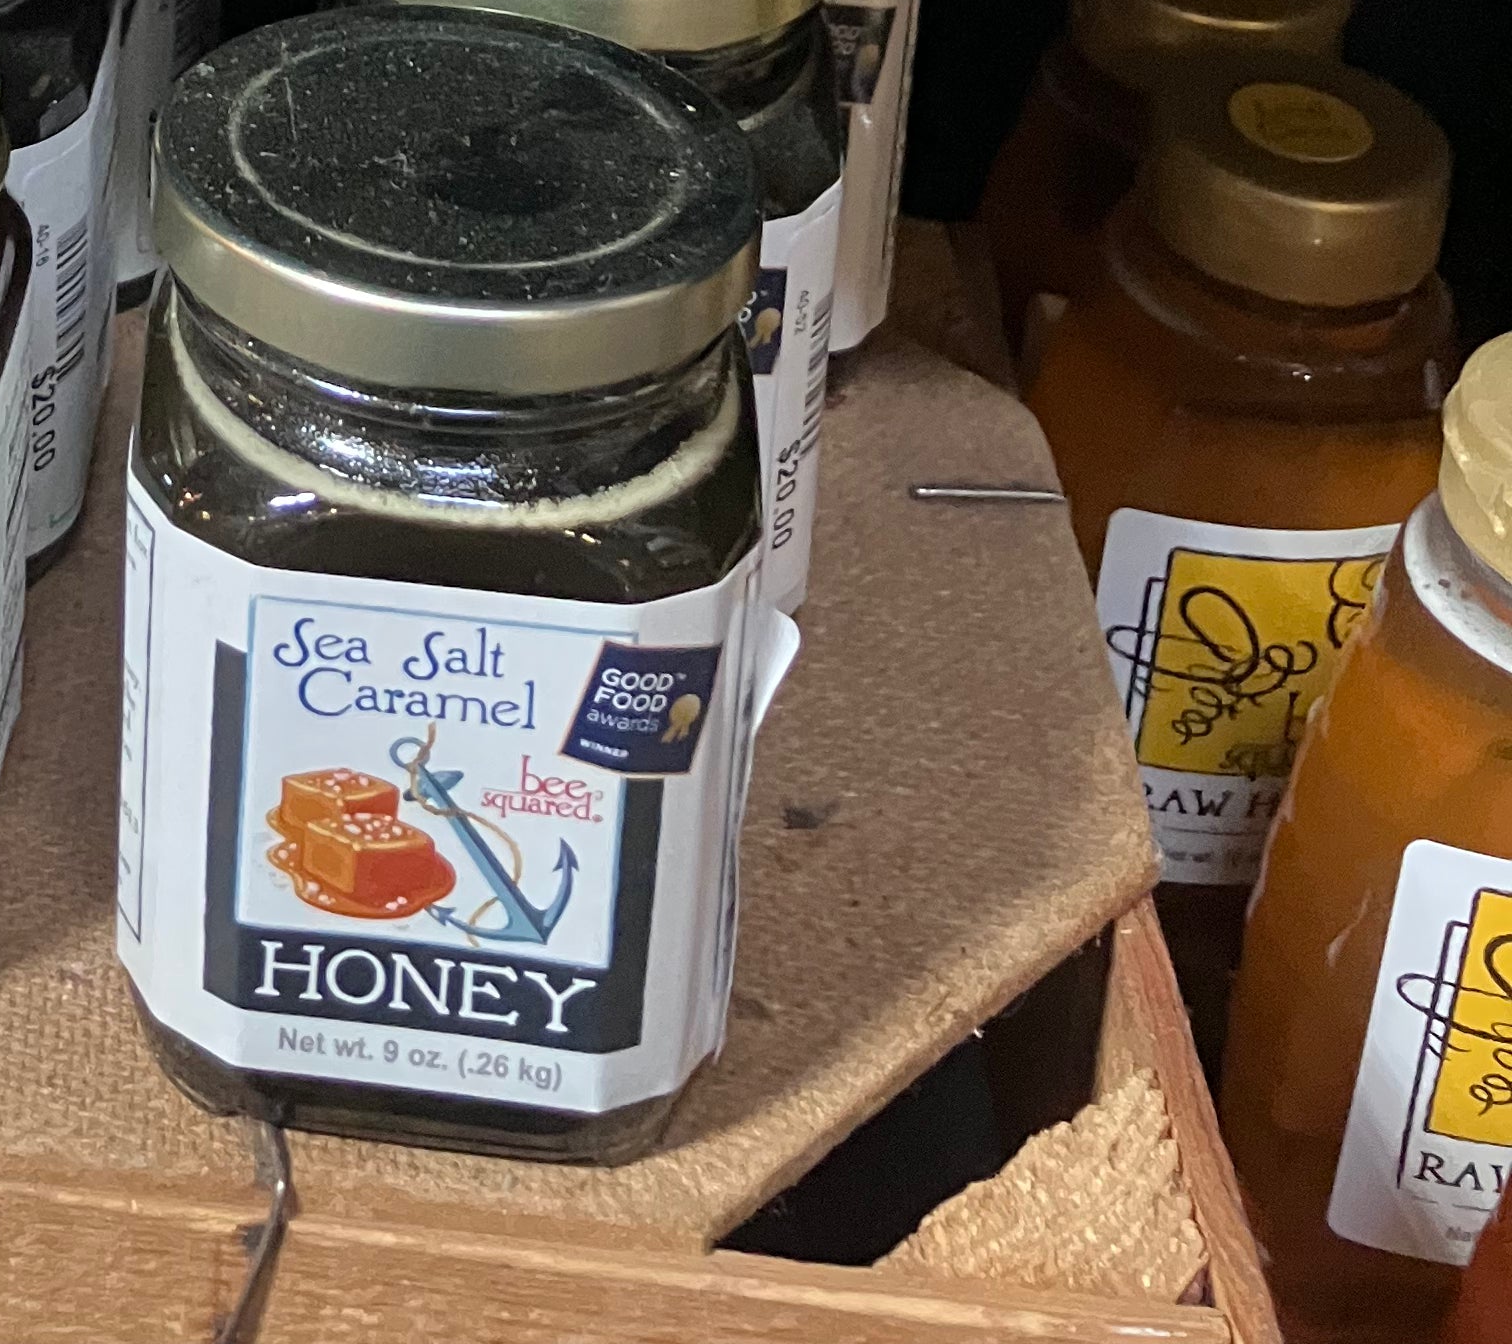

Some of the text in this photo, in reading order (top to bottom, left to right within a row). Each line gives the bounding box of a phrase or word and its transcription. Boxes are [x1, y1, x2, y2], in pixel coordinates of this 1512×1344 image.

[31, 365, 57, 472] $20.00
[772, 439, 800, 550] $20.00
[272, 617, 505, 682] Sea Salt
[601, 667, 674, 692] GOOD
[297, 667, 537, 731] Caramel
[586, 708, 660, 732] awards
[593, 685, 668, 712] FOOD
[521, 754, 587, 799] bee
[254, 939, 597, 1034] HONEY
[277, 1026, 562, 1092] Net wt. 9 oz. (.26 kg)
